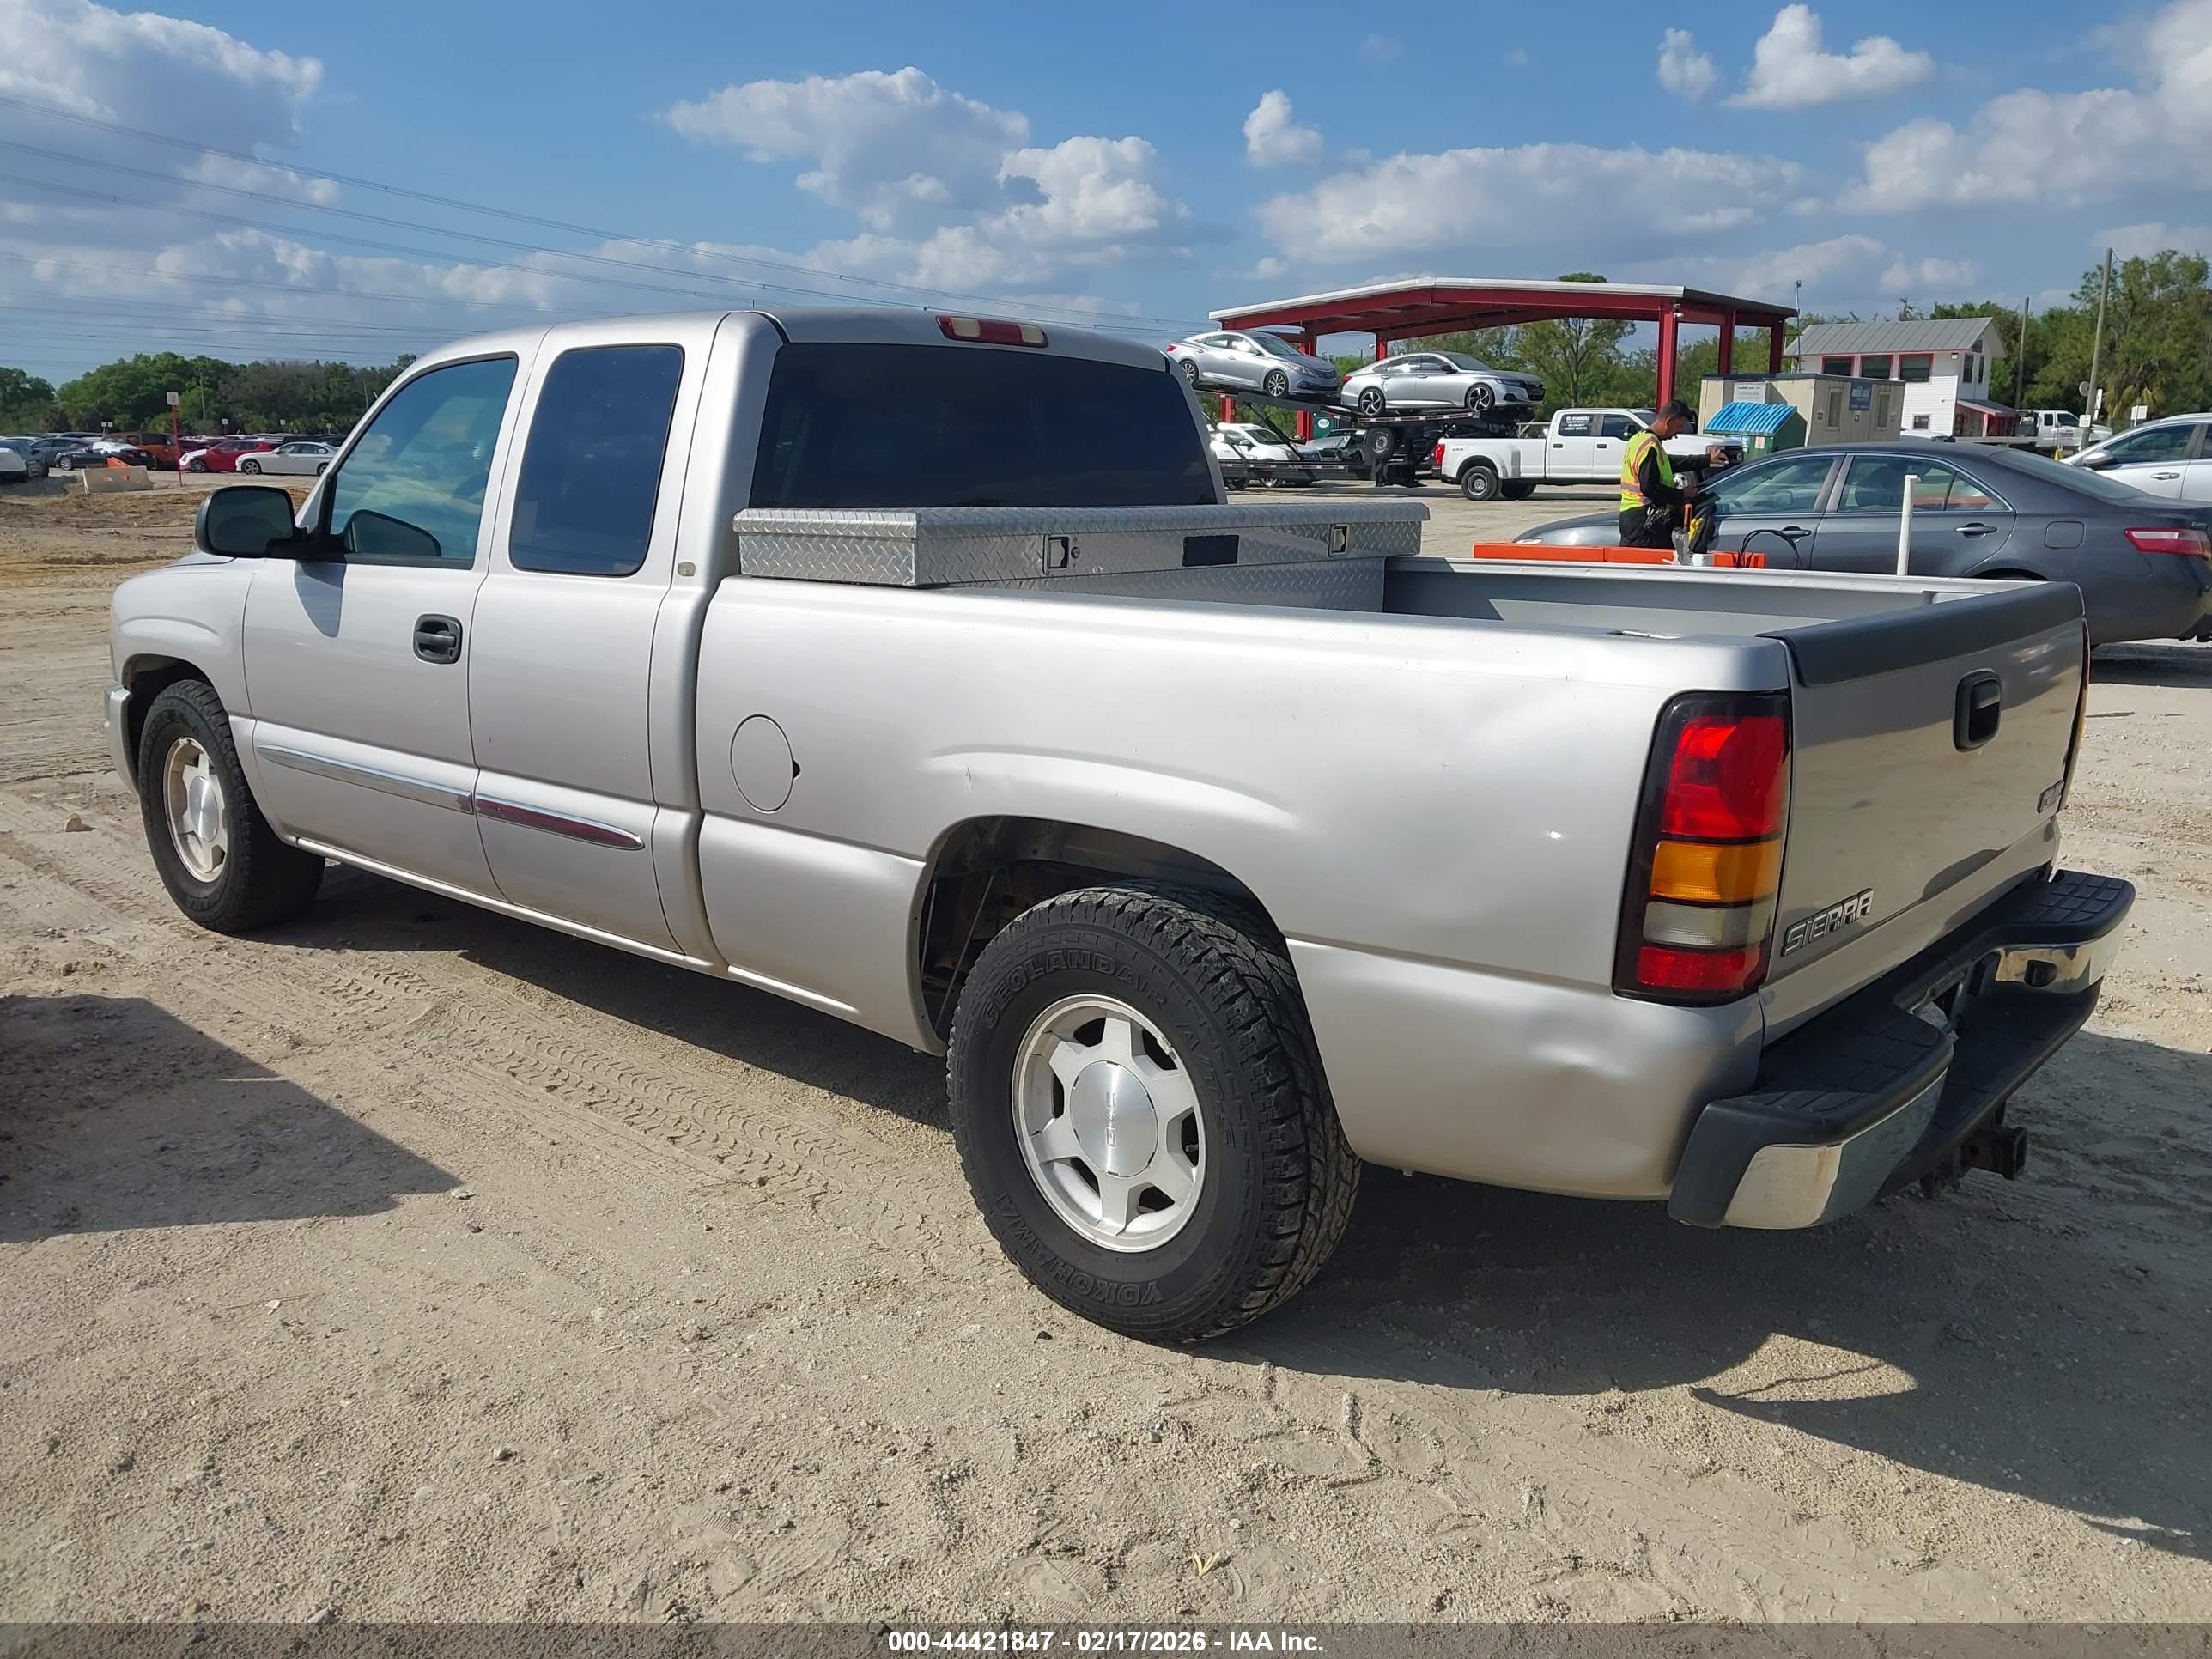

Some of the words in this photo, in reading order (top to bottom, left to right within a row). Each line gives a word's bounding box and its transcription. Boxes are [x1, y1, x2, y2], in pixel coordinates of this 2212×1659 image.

[1781, 888, 1874, 957] SIERRA
[981, 948, 1167, 1030] GEOLANDAR
[995, 1194, 1164, 1308] YOKOHAMA
